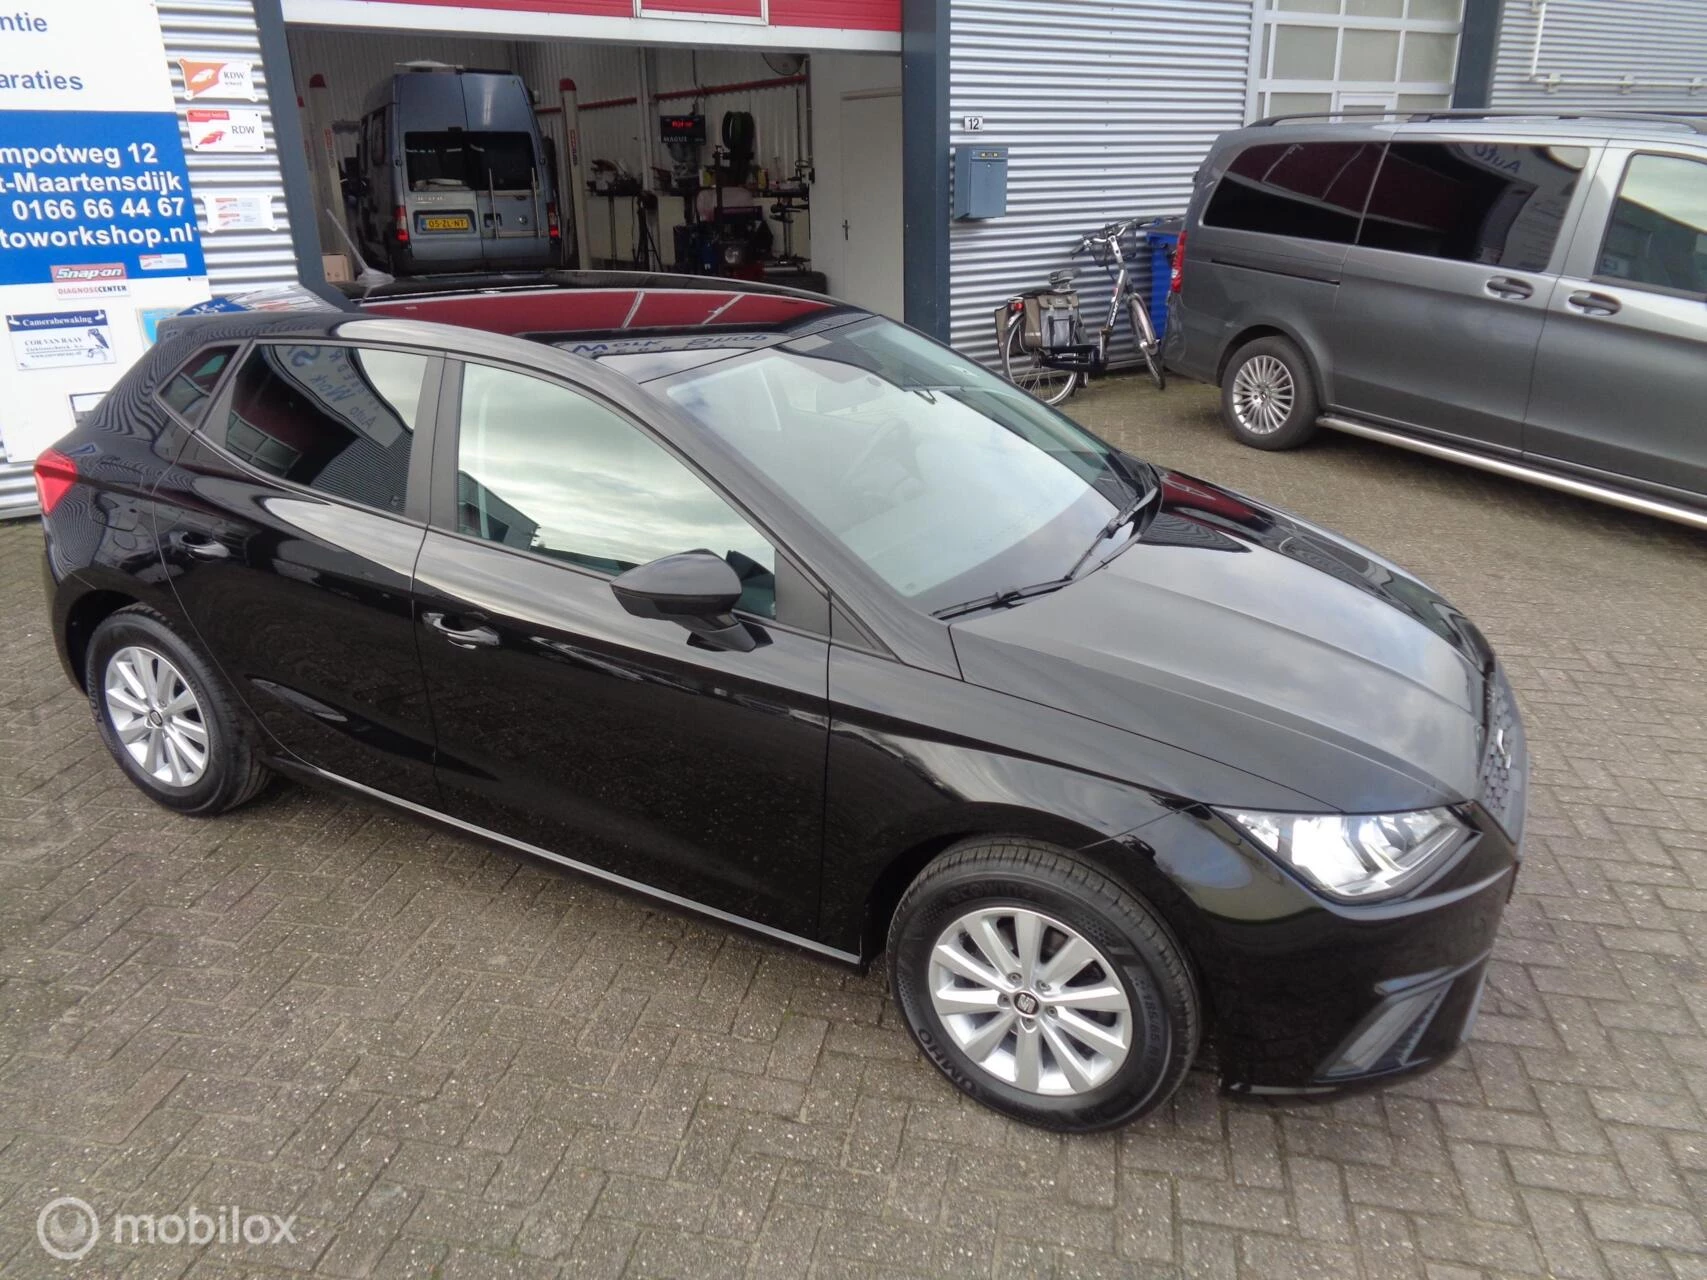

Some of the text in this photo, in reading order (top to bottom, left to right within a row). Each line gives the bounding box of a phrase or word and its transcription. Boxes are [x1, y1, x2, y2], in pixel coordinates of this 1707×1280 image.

[0, 12, 48, 32] ntie
[0, 70, 84, 90] araties
[223, 71, 245, 80] RDW
[231, 125, 255, 135] RDW
[968, 118, 980, 130] 12
[0, 143, 158, 168] mpotweg 12
[12, 197, 184, 220] 0166 66 44 67
[56, 267, 122, 280] Snap-on
[22, 316, 93, 327] Camerabewaking
